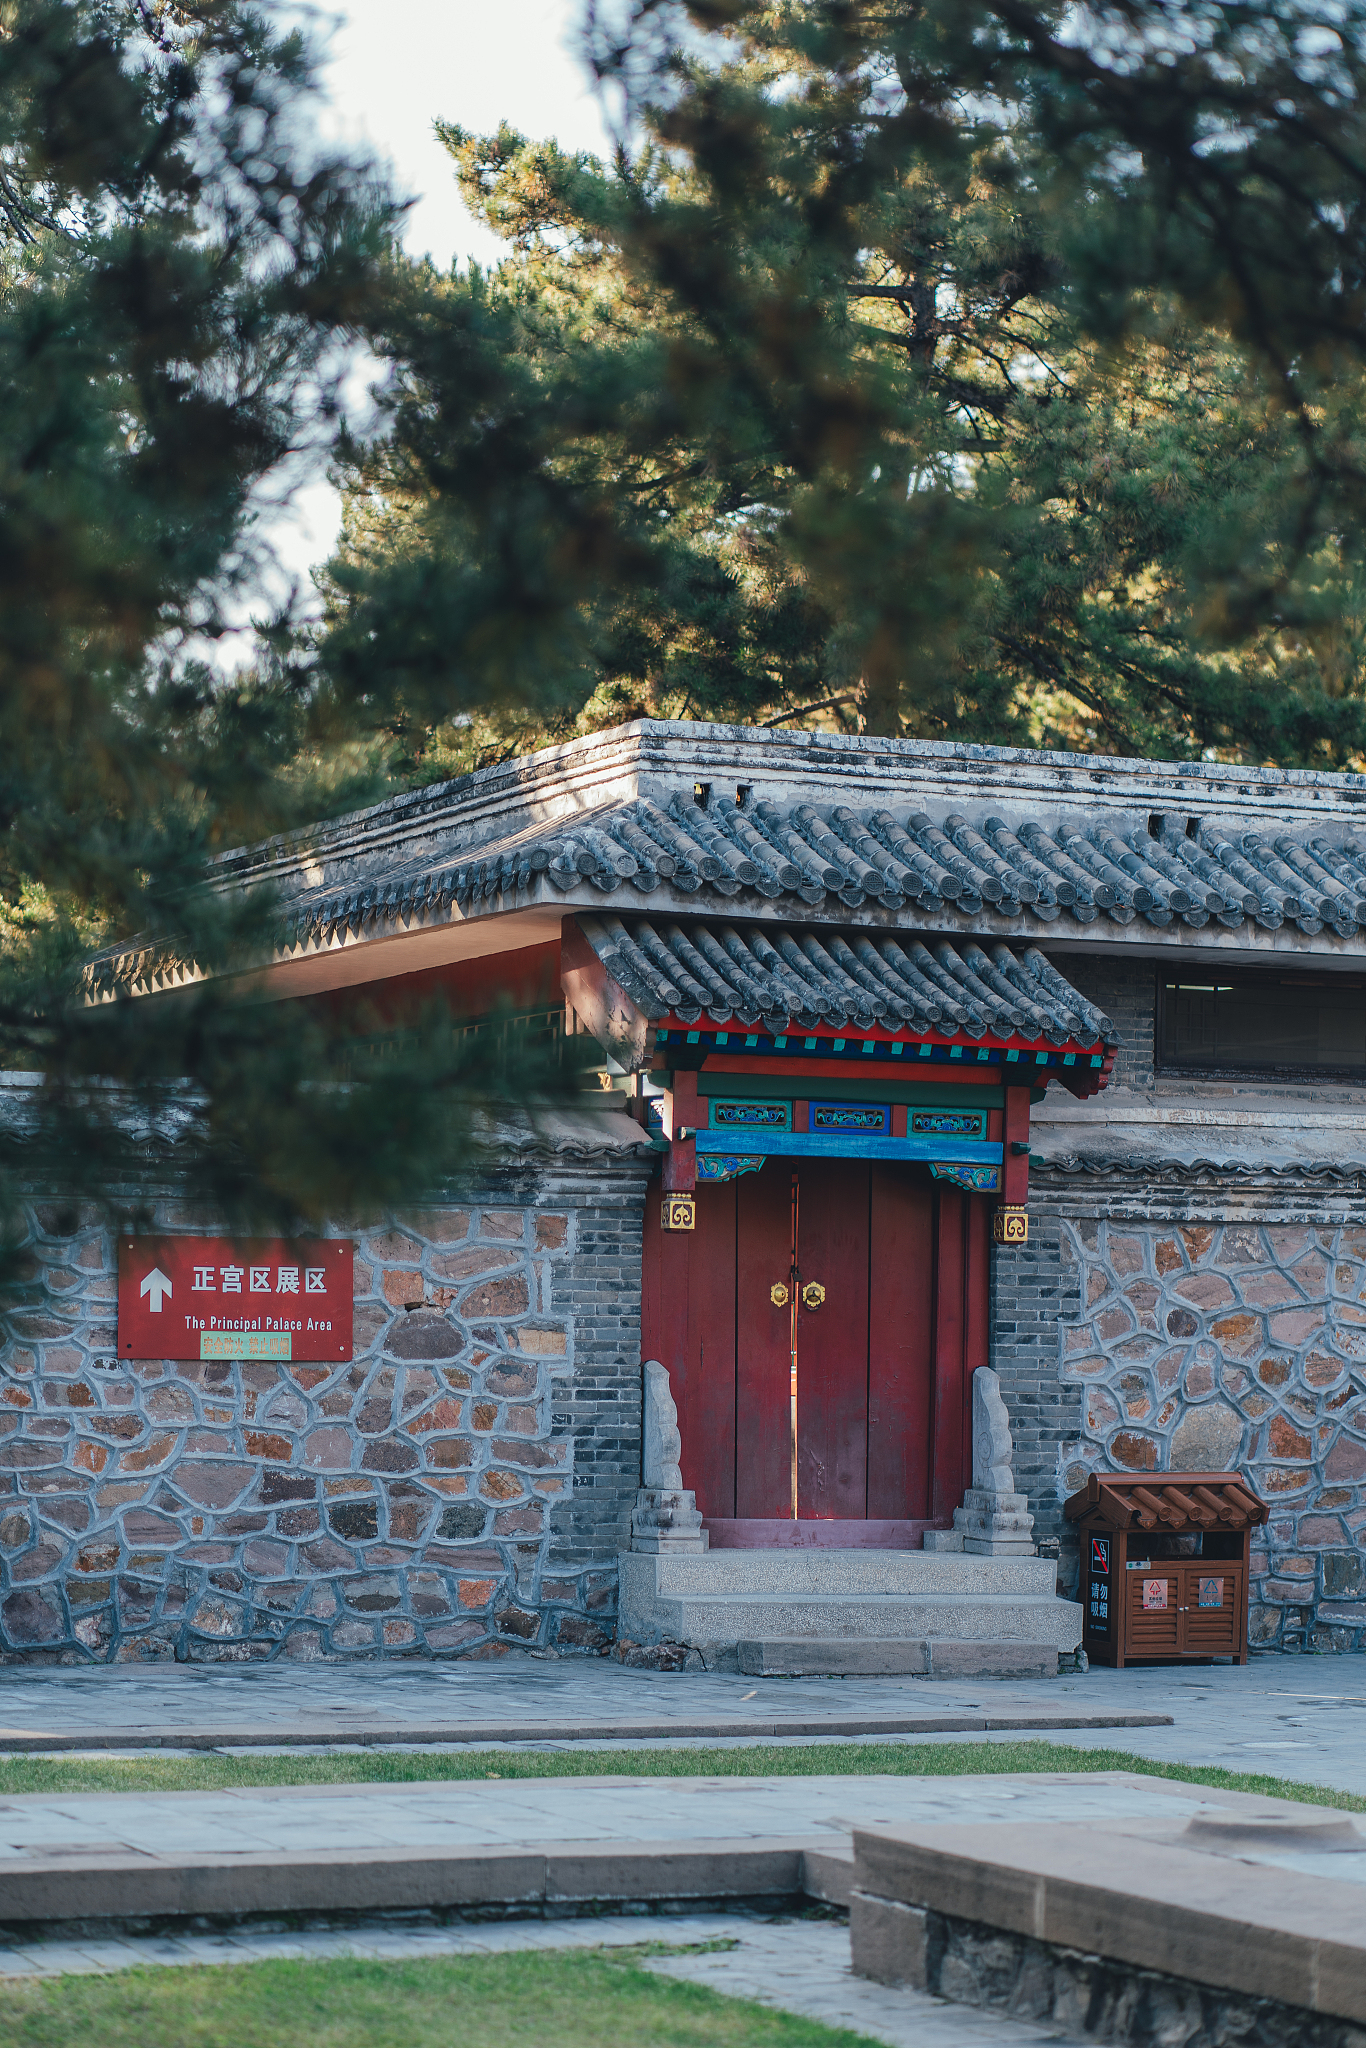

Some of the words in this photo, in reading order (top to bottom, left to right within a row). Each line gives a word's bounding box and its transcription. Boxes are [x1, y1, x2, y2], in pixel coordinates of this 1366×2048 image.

[191, 1265, 328, 1294] 正宫区展区
[185, 1315, 206, 1330] The
[210, 1316, 262, 1333] Principal
[266, 1317, 302, 1331] Palace
[307, 1318, 333, 1331] Area
[203, 1337, 243, 1355] 安全防火
[249, 1337, 290, 1355] 禁止吸烟
[1091, 1582, 1108, 1600] 请勿
[1091, 1601, 1108, 1619] 吸烟
